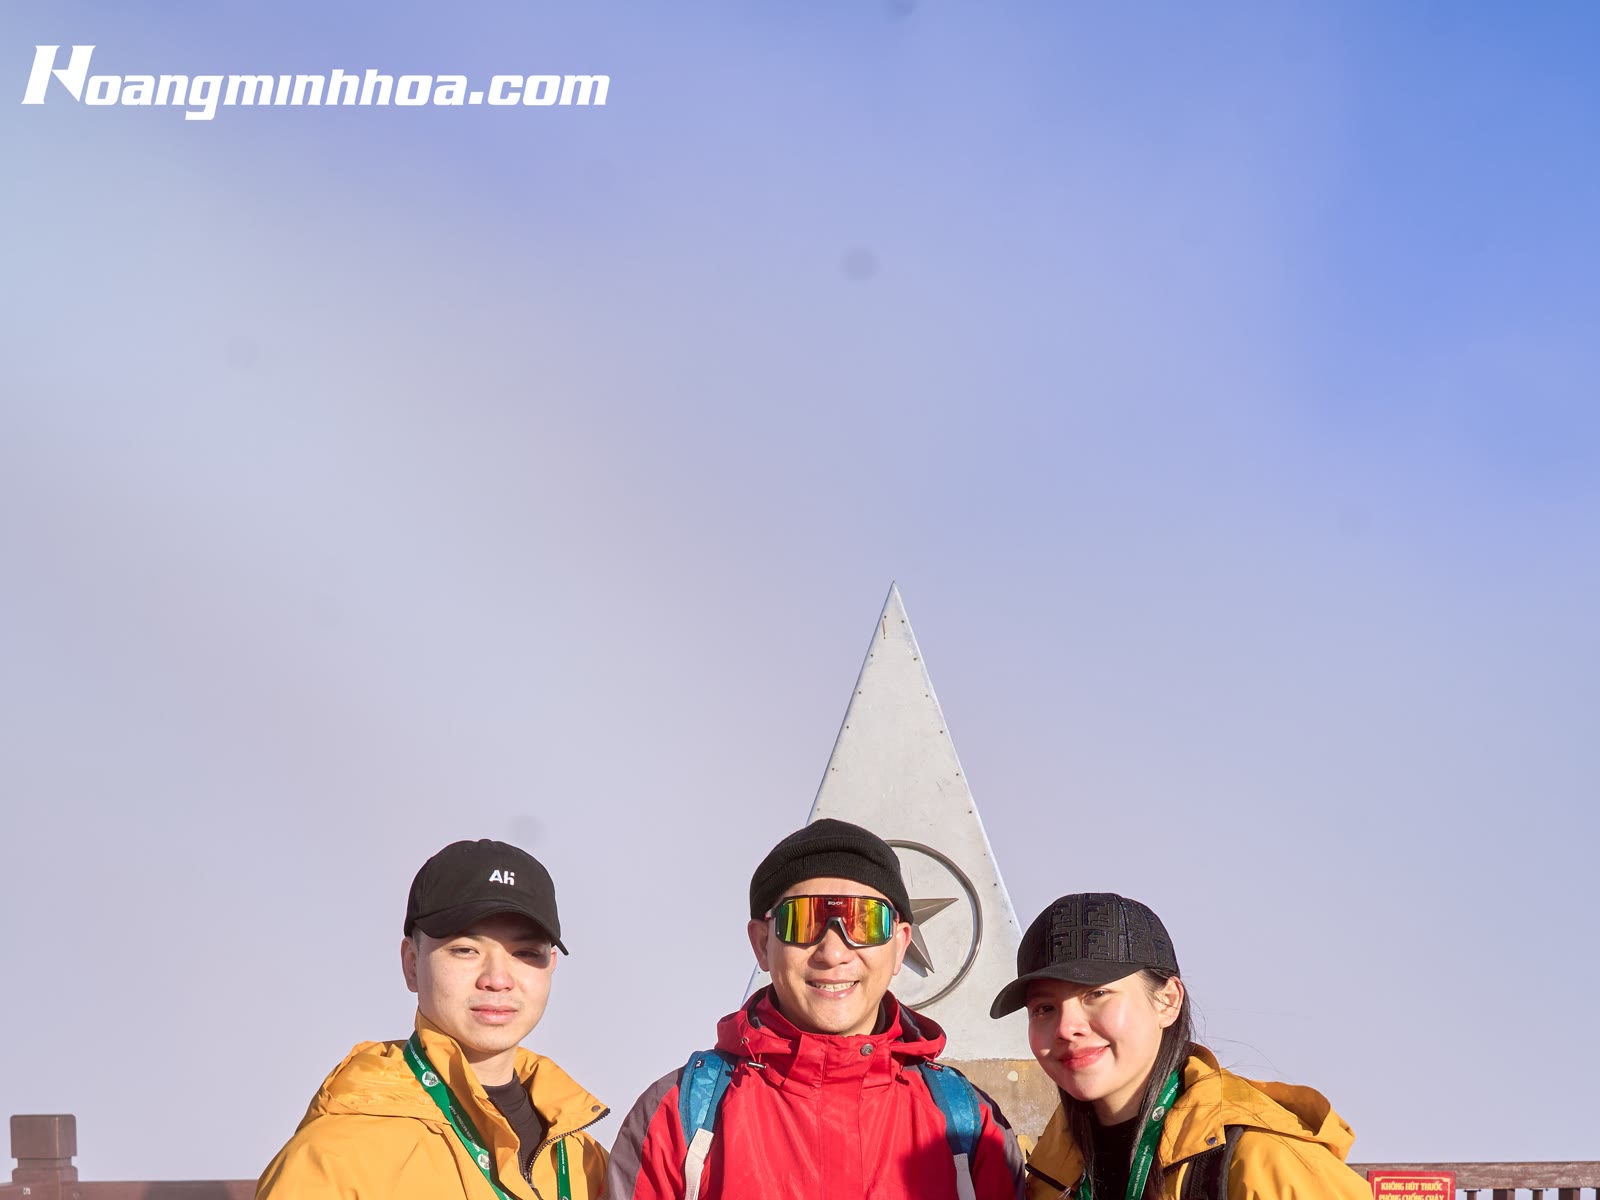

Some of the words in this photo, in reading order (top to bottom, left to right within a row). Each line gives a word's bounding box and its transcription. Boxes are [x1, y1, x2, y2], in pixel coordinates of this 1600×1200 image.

[455, 1114, 468, 1132] NATIONAL
[1381, 1181, 1404, 1190] KHÔNG
[1405, 1181, 1419, 1190] HÚT
[1421, 1180, 1442, 1191] THUỐC
